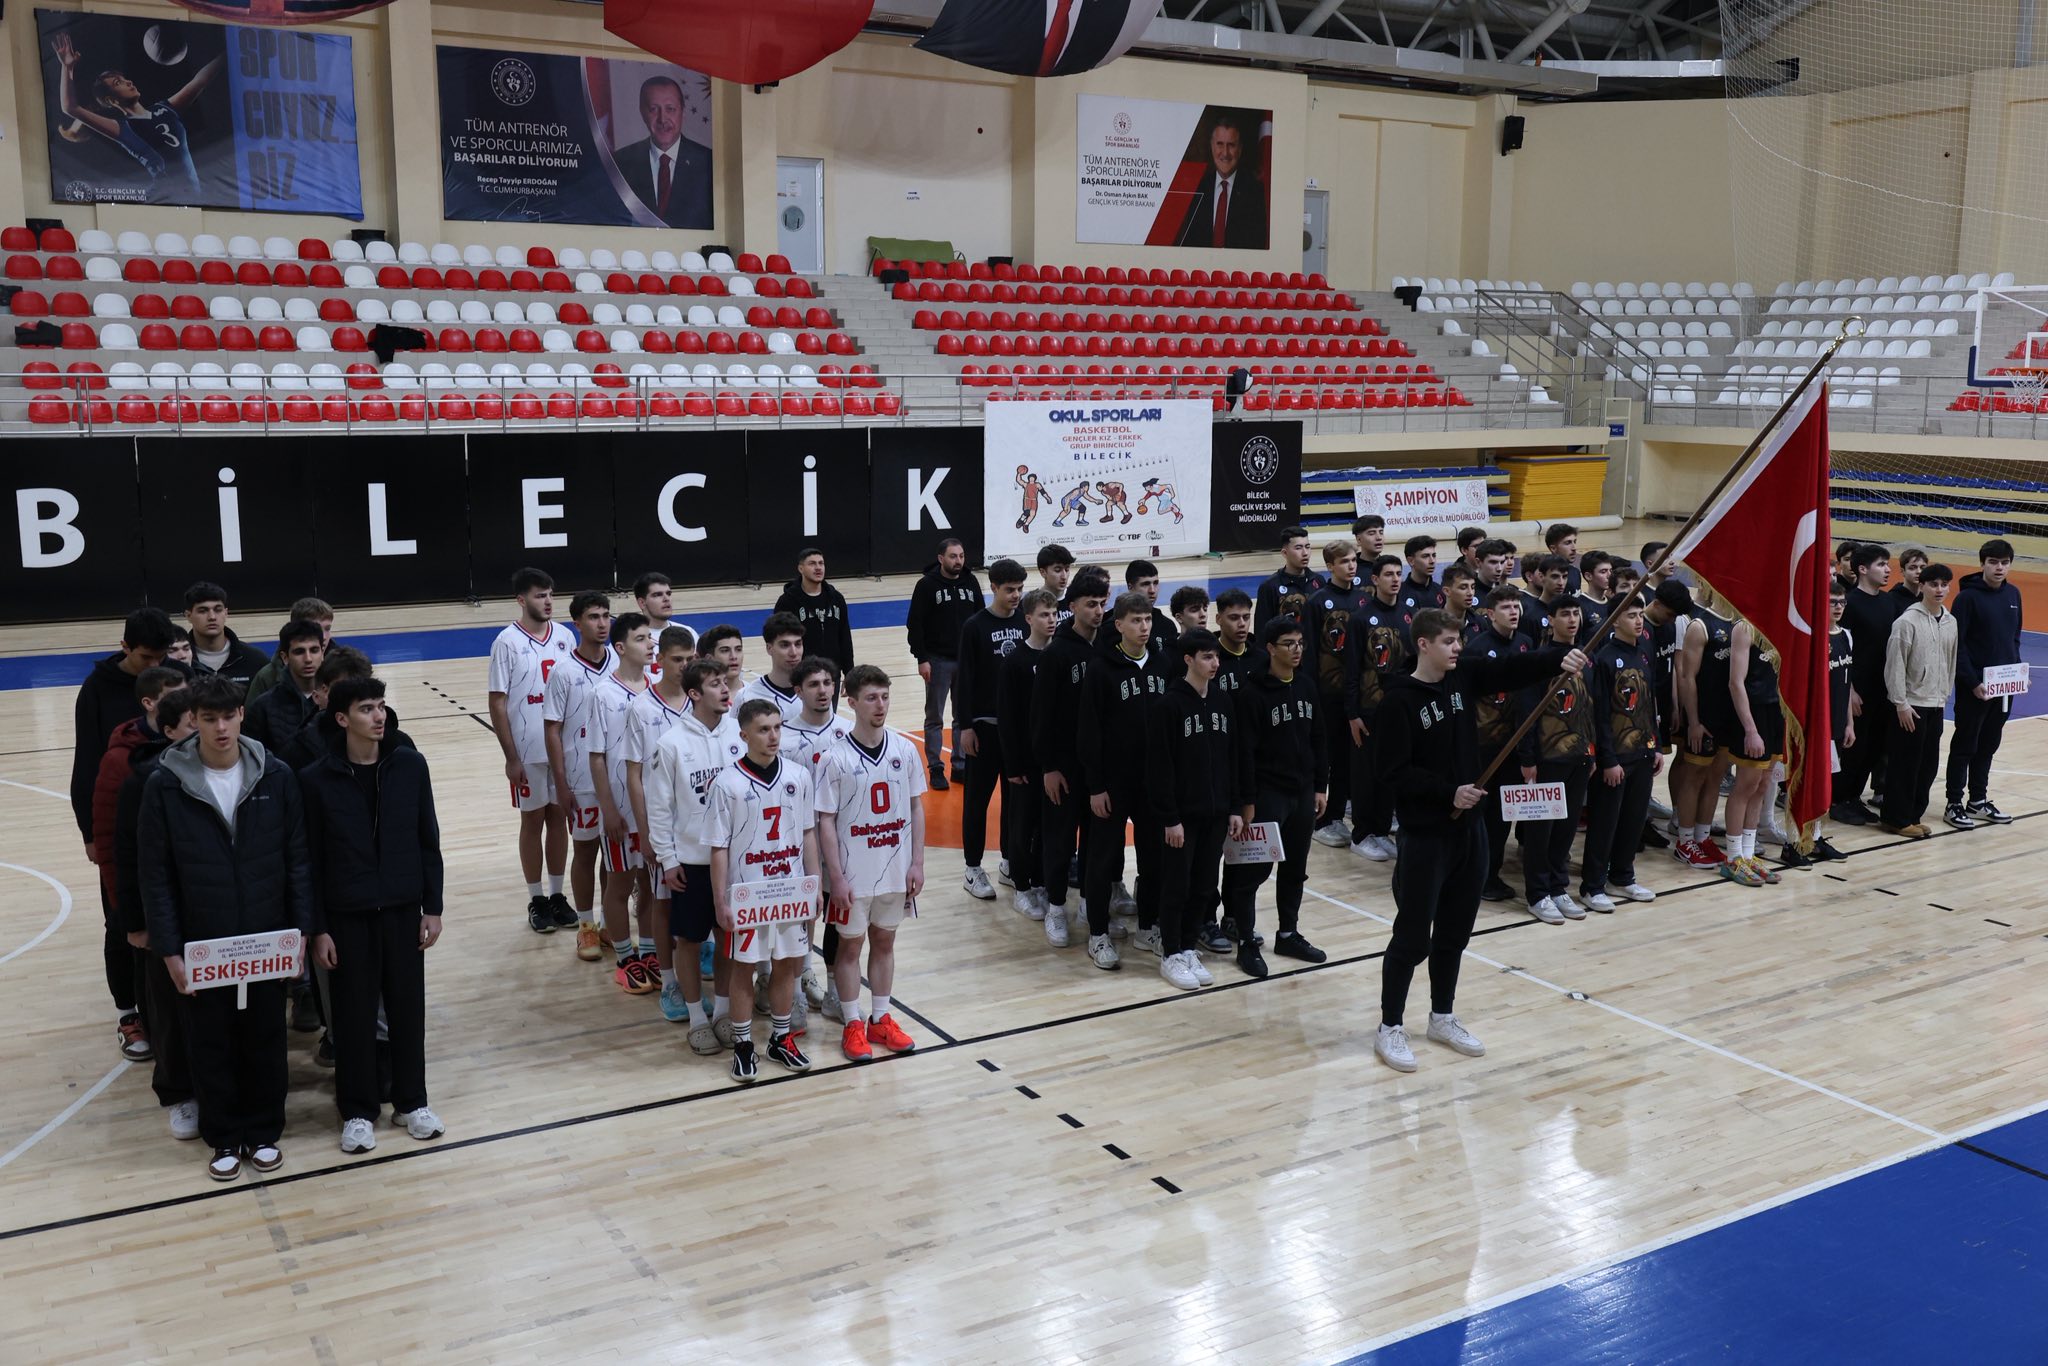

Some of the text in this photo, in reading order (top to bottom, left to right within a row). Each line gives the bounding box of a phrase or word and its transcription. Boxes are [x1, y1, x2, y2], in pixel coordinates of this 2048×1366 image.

[239, 28, 317, 82] SPOR
[464, 118, 568, 137] TÜM ANTRENÖR
[155, 123, 180, 148] 3
[450, 136, 583, 155] VE SPORCULARIMIZA
[454, 152, 578, 169] BAŞARILAR DİLİYORUM
[1083, 154, 1160, 168] TÜM ANTRENÖR VE
[1086, 165, 1158, 178] SPORCULARIMIZA
[477, 176, 558, 186] Recep Tayyip ERDOĞAN
[1081, 177, 1162, 189] BAŞARILAR DİLİYORUM
[480, 185, 556, 196] T.C. CUMHURBAŞKANI
[1088, 198, 1112, 206] GENÇLİK
[1049, 408, 1162, 423] OKUL SPORLARI
[1073, 426, 1132, 434] BASKETBOL
[1246, 490, 1270, 499] BİLECİK
[1384, 487, 1458, 510] ŞAMPİYON
[1229, 501, 1287, 512] GENÇLİK VE SPOR İL
[1238, 513, 1277, 523] MÜDÜRLÜĞÜ
[1386, 514, 1413, 526] GENÇLİK
[1413, 516, 1421, 524] VE
[1422, 515, 1438, 524] SPOR
[1445, 511, 1486, 522] MÜDÜRLÜĞÜ
[1987, 681, 2026, 696] İSTANBUL
[870, 782, 891, 814] 0
[1503, 787, 1561, 805] BALIKESİR
[576, 806, 599, 829] 12
[762, 806, 782, 841] 7
[867, 834, 899, 849] Koleji
[763, 861, 792, 877] Koleji
[737, 901, 810, 925] SAKARYA
[738, 928, 756, 953] 7
[192, 953, 293, 983] ESKİŞEHİR
